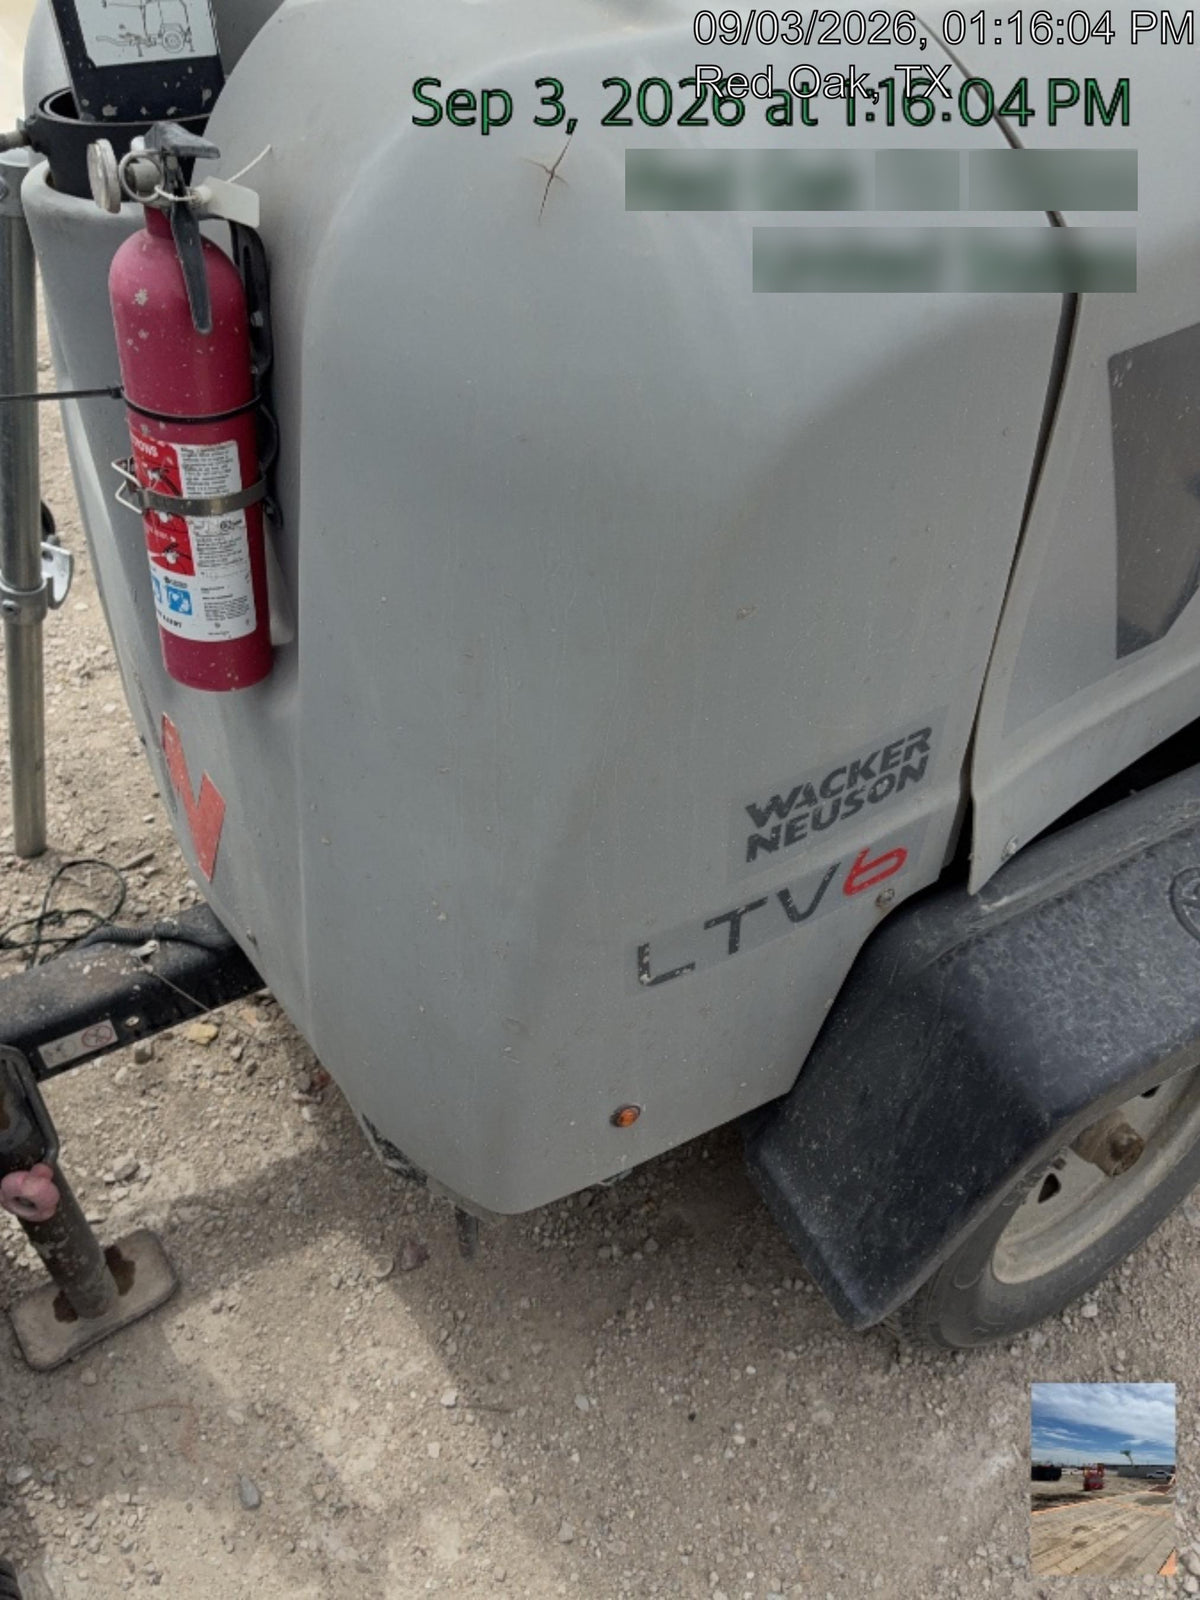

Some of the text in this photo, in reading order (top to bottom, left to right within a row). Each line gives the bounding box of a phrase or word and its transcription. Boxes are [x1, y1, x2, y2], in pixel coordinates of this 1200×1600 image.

[745, 727, 932, 829] WACKER
[745, 754, 929, 863] NEUSON
[637, 847, 908, 986] LTV6
